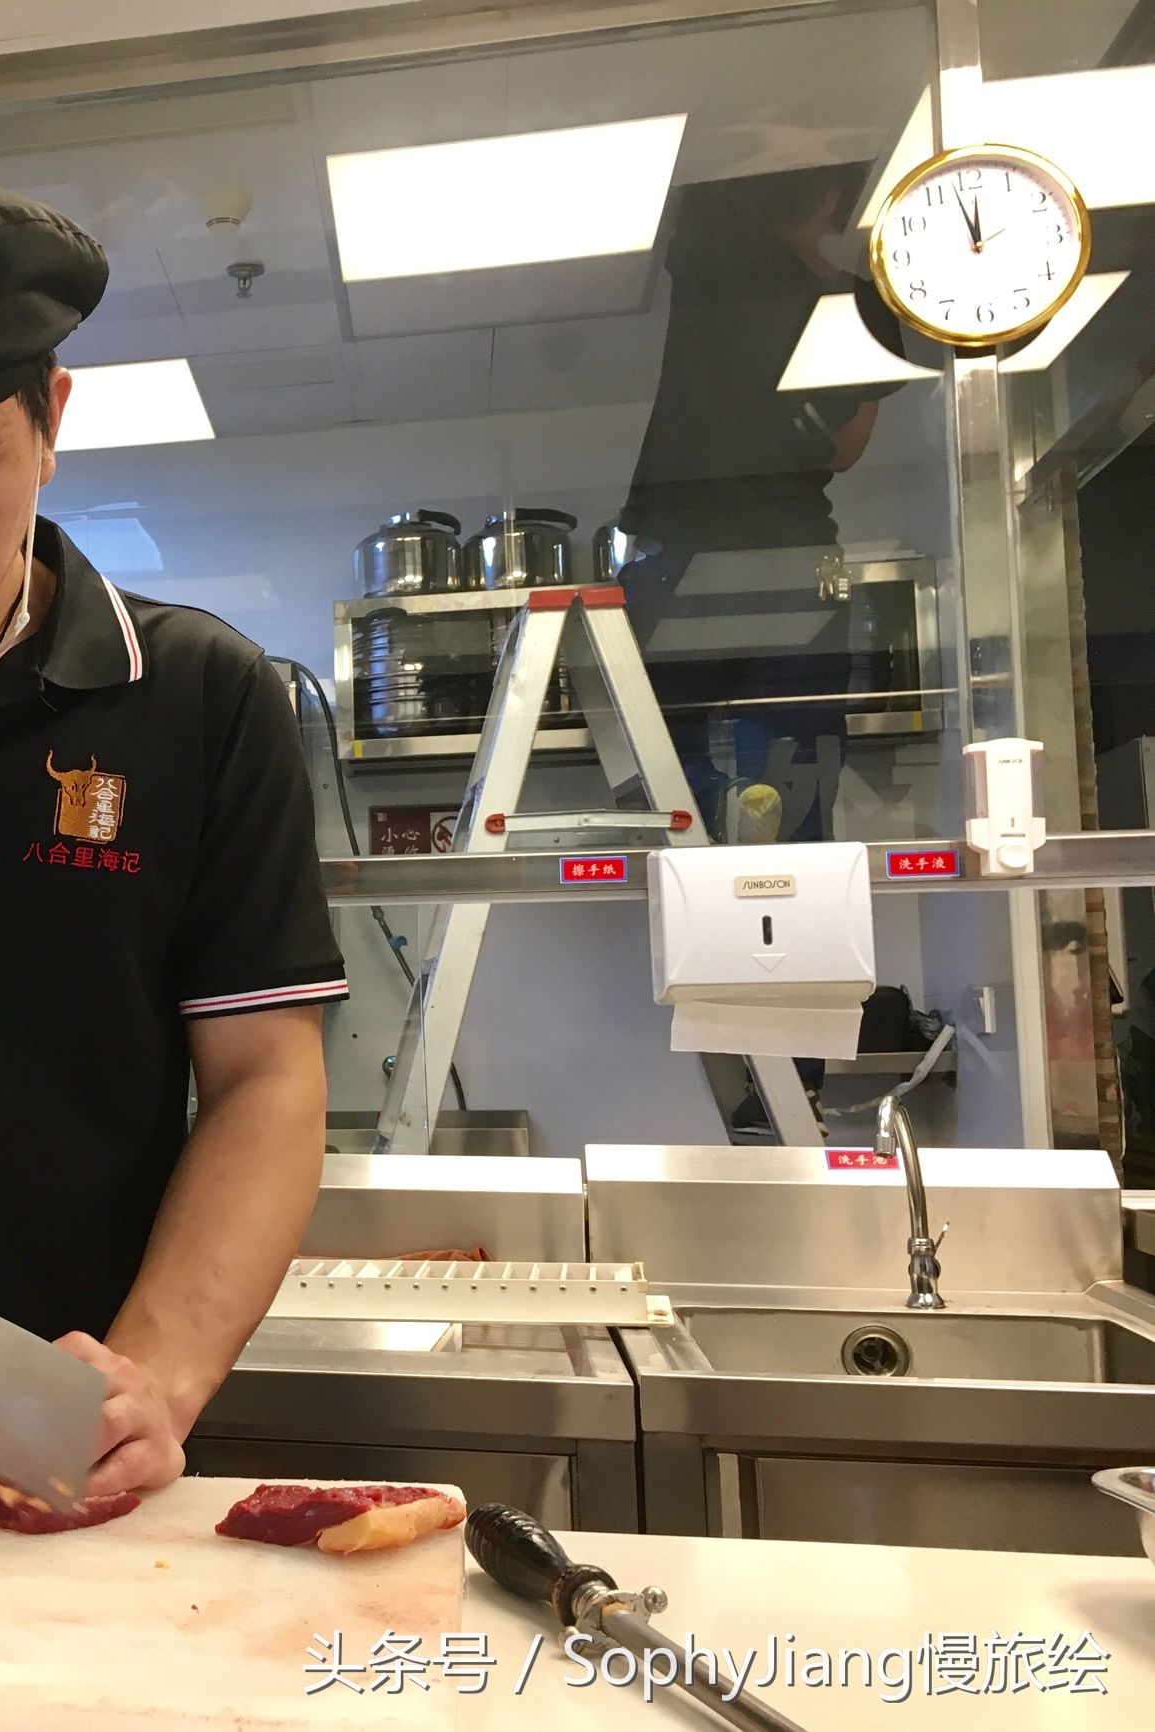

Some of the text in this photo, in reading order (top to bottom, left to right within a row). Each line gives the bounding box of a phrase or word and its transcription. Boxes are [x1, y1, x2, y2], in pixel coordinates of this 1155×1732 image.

[956, 168, 983, 192] 12
[1005, 172, 1012, 192] 1
[925, 185, 944, 206] 11
[1030, 191, 1048, 213] 2
[900, 215, 927, 236] 10
[1046, 224, 1064, 245] 3
[892, 249, 911, 270] 9
[1037, 260, 1056, 281] 4
[909, 279, 927, 301] 8
[1012, 287, 1031, 310] 5
[938, 298, 956, 321] 7
[975, 302, 995, 324] 6
[380, 826, 421, 843] 小心
[22, 841, 142, 874] 八合里海记
[898, 856, 947, 871] 洗手液
[571, 863, 617, 877] 擦手纸
[742, 879, 791, 890] SUNBOSON
[837, 1154, 888, 1166] 洗手池
